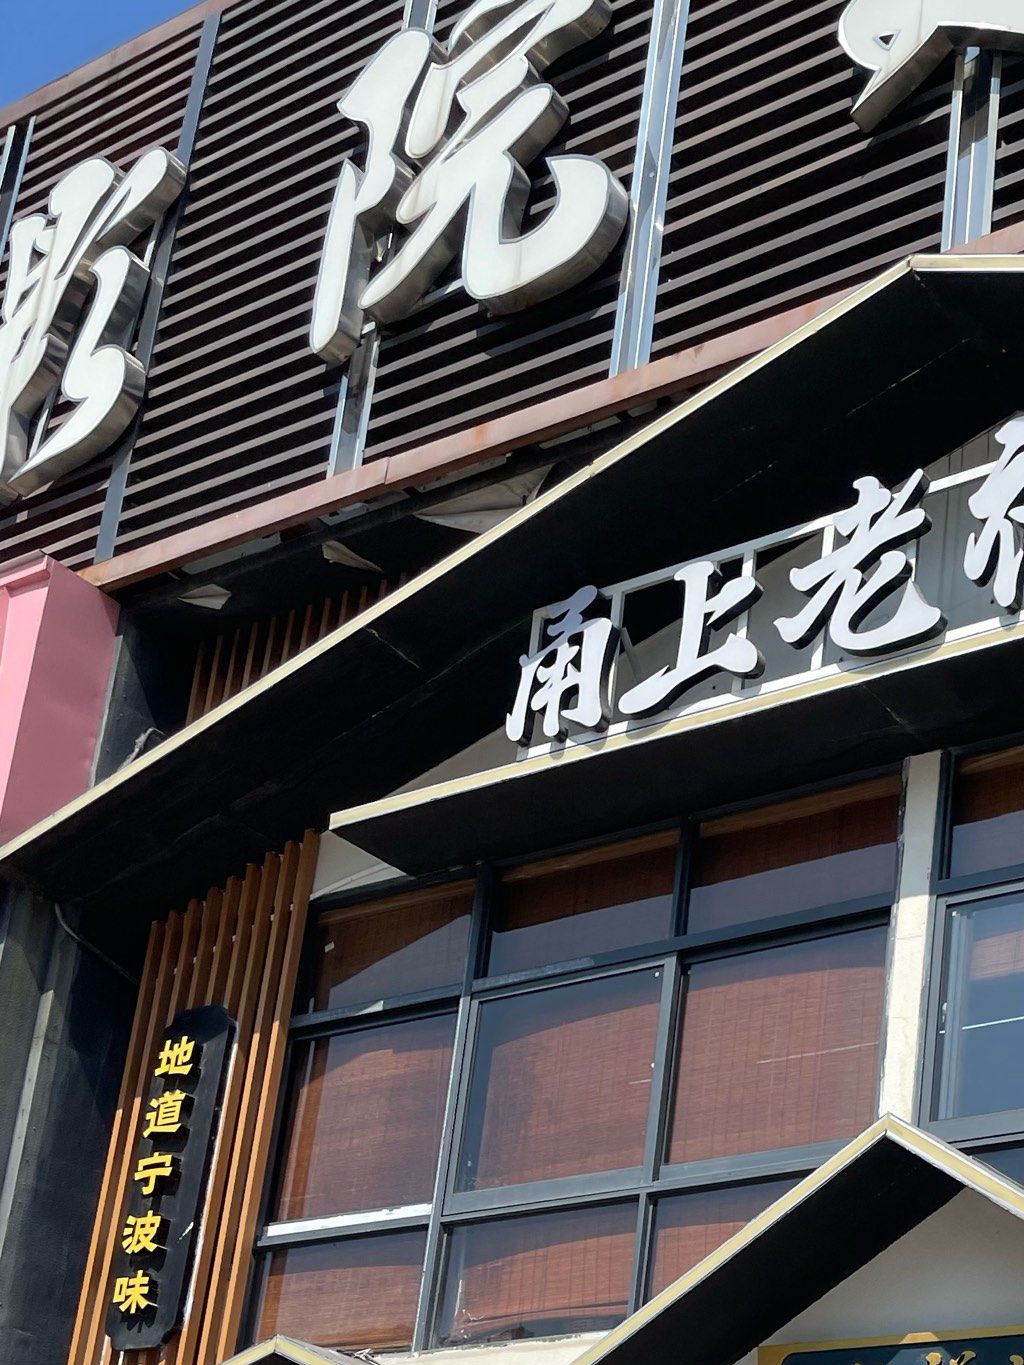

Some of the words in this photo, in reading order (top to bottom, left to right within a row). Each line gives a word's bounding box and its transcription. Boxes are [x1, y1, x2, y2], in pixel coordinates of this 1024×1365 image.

[112, 1035, 196, 1314] 地道宁波味
